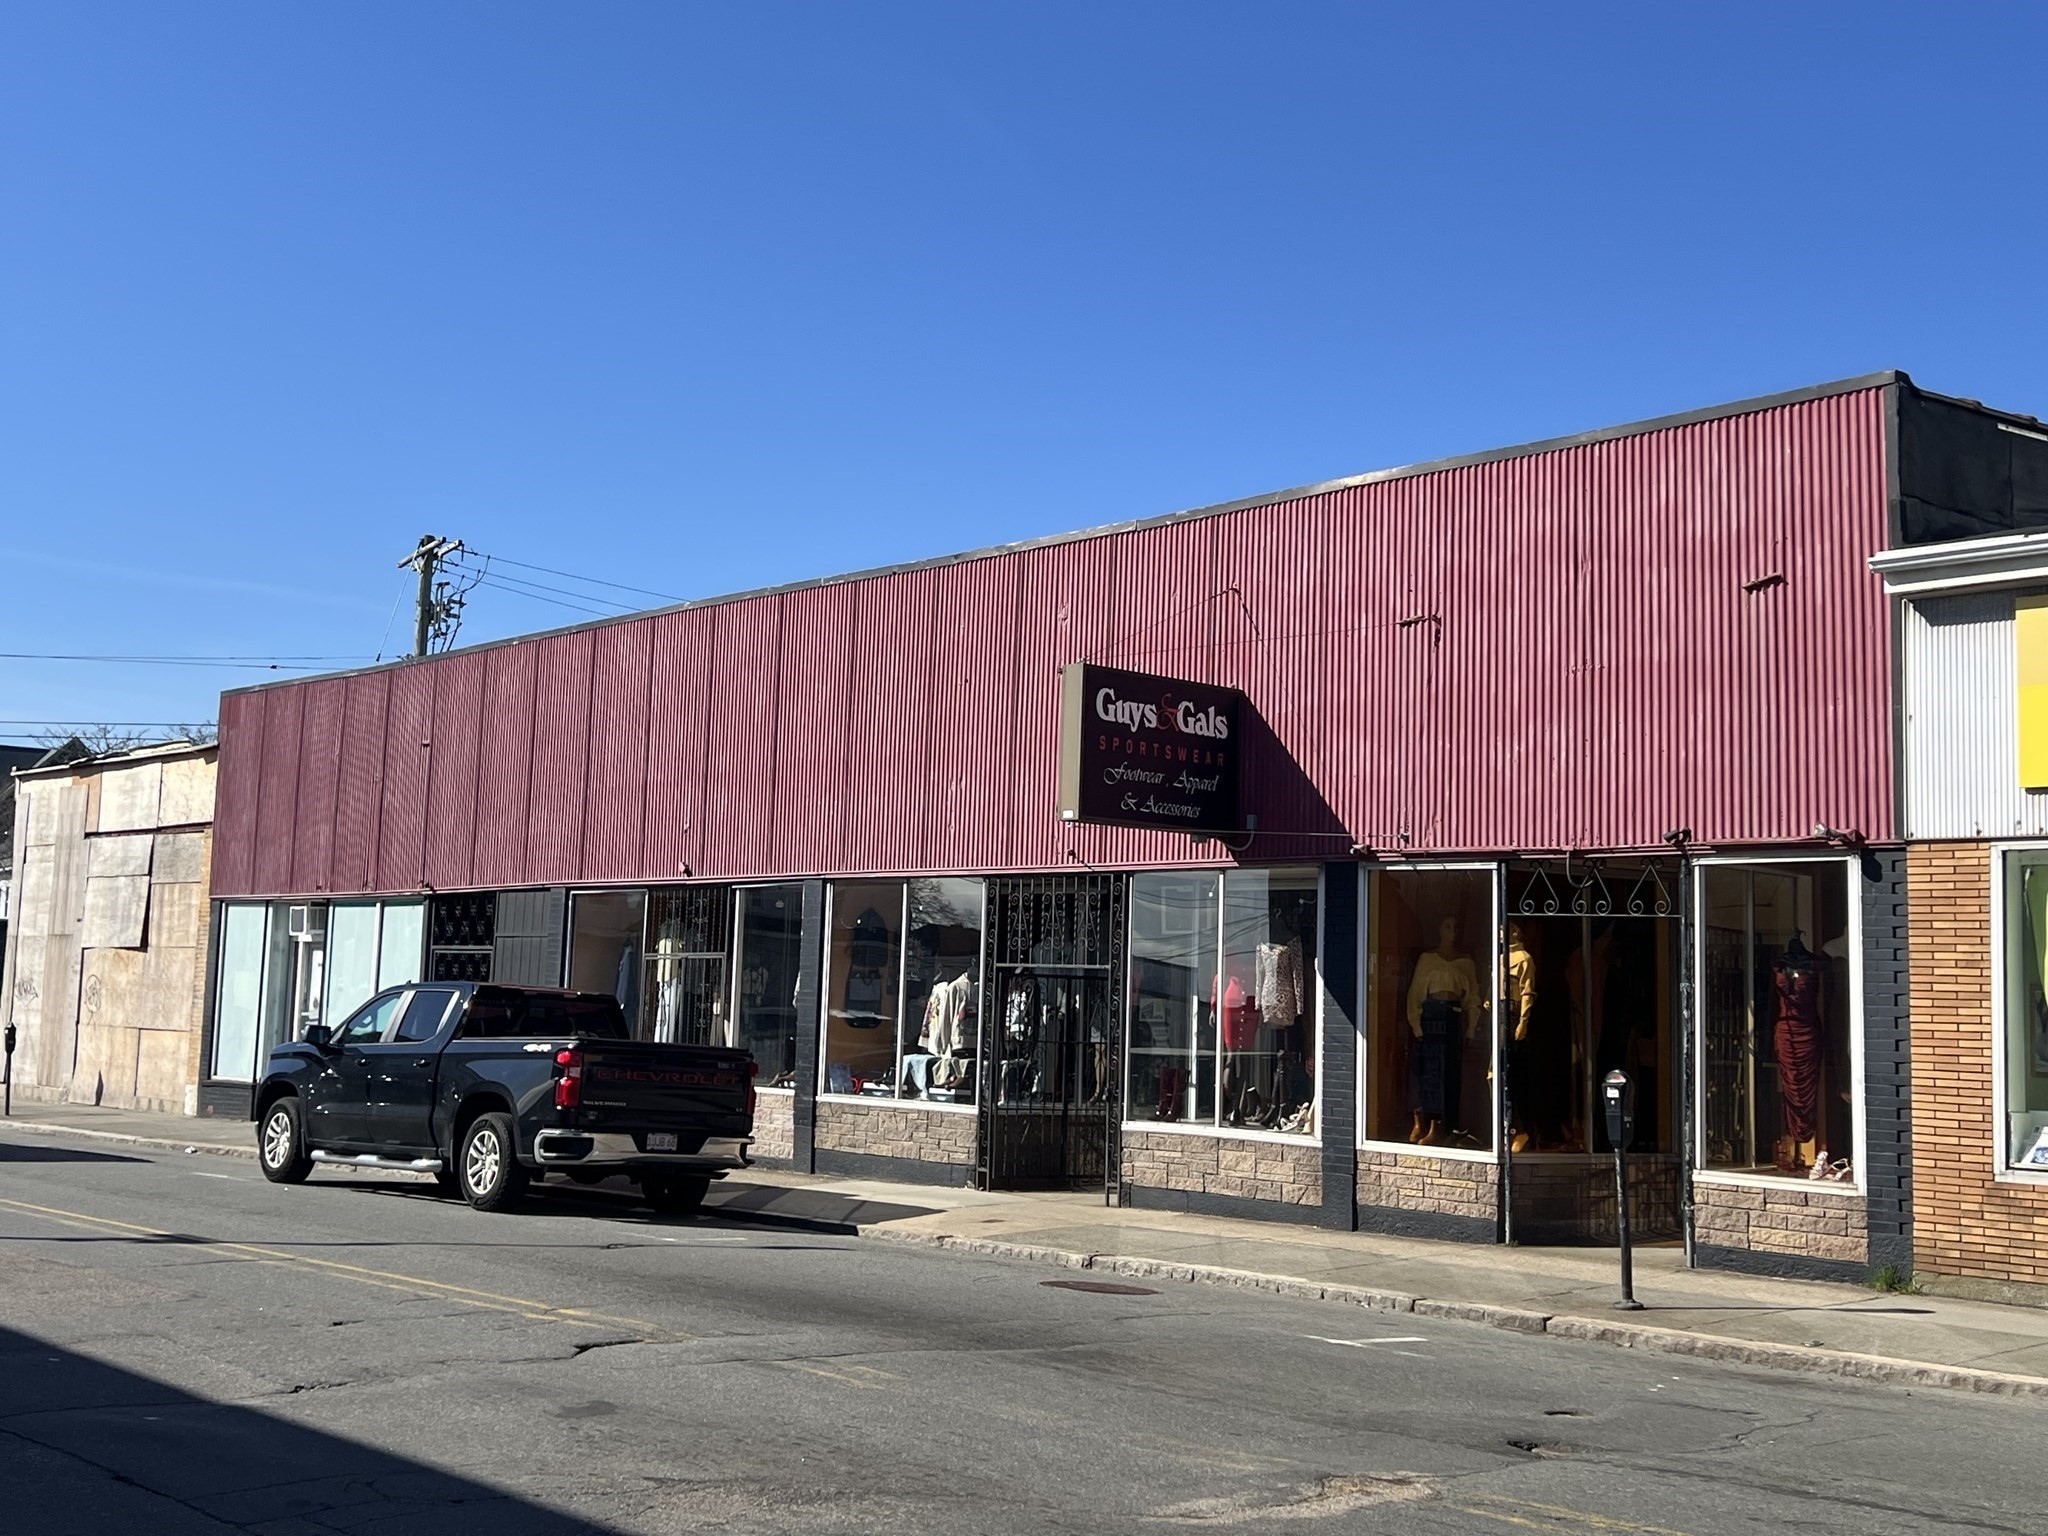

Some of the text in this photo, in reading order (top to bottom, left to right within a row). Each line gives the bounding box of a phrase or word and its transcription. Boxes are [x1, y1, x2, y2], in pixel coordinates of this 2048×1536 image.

[1095, 687, 1157, 733] Guys
[1177, 700, 1228, 739] Gals
[1099, 735, 1225, 766] SPORTSWEAR
[1173, 768, 1219, 794] Apparel
[1121, 791, 1201, 818] & Accessories
[596, 1068, 742, 1085] CHEVROLET
